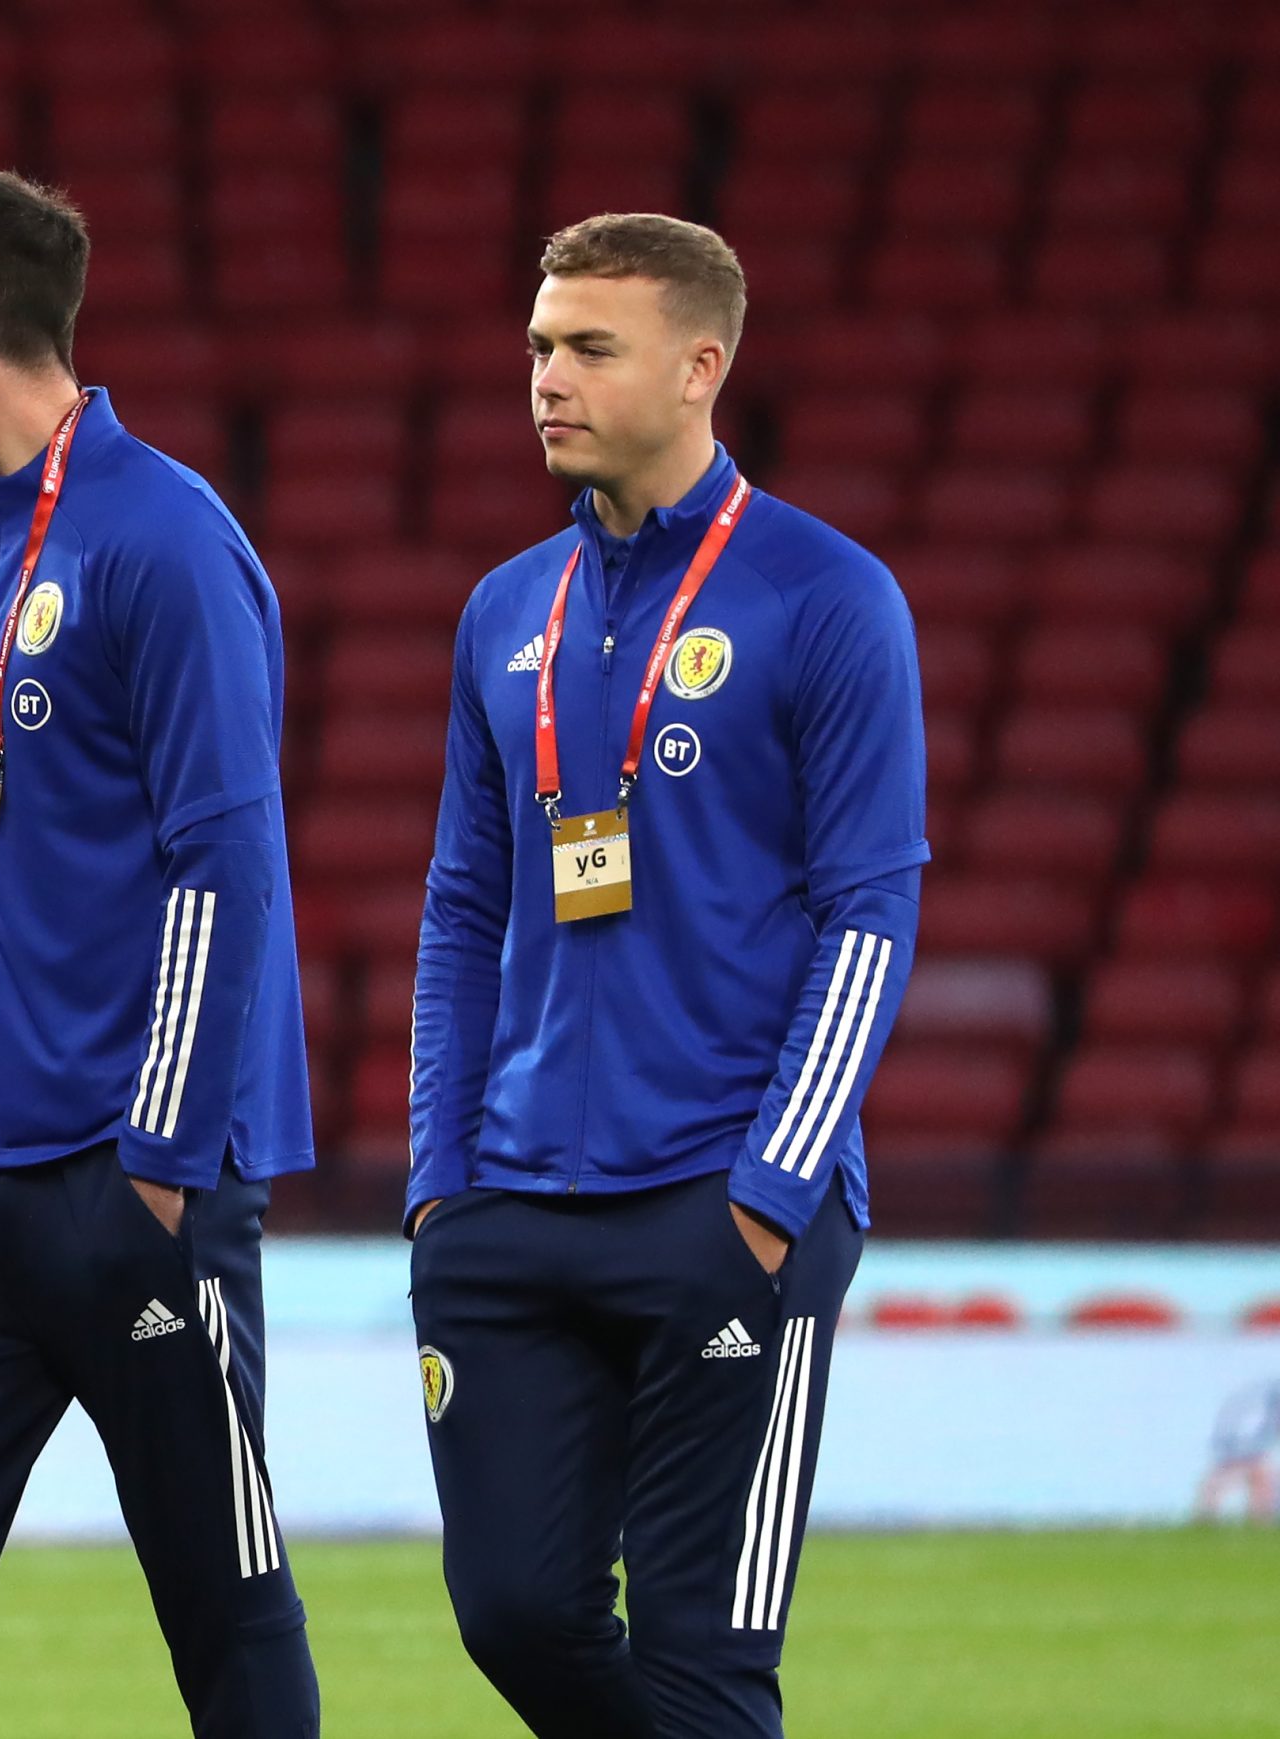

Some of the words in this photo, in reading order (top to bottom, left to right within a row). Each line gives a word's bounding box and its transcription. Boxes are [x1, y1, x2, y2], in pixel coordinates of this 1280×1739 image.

[48, 433, 66, 478] EUROPEAN
[0, 619, 14, 664] EUROPEAN
[646, 642, 668, 687] EUROPEAN
[19, 694, 41, 715] BT
[664, 738, 690, 761] BT
[575, 847, 607, 878] yG
[131, 1318, 186, 1341] adidas
[701, 1343, 761, 1359] adidas
